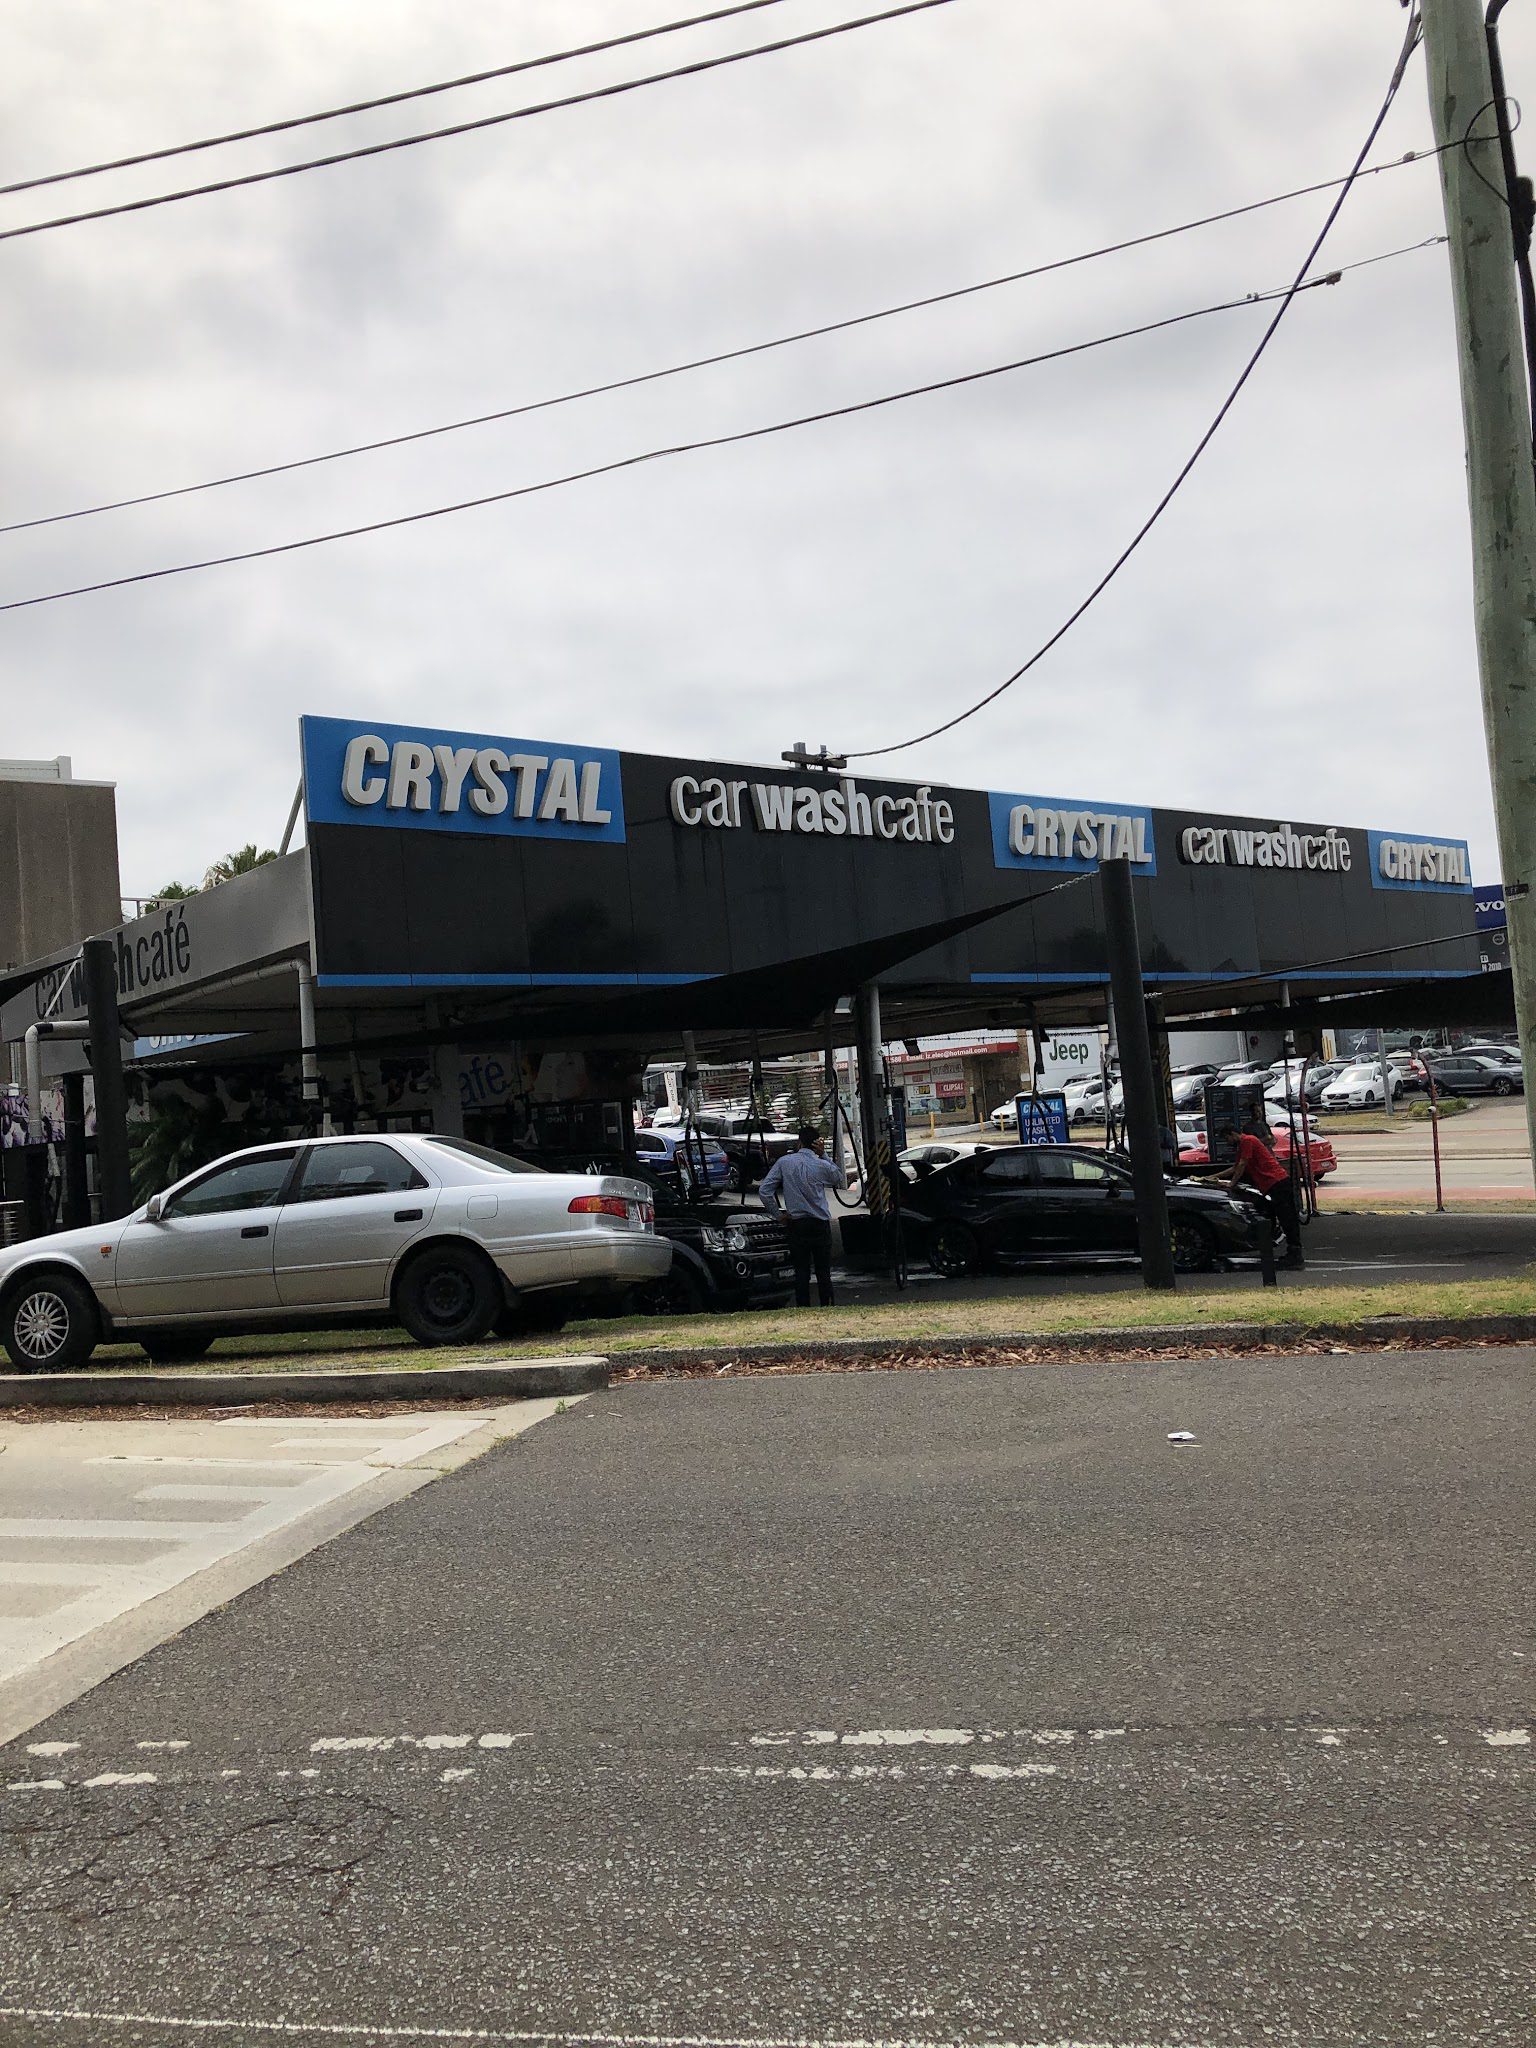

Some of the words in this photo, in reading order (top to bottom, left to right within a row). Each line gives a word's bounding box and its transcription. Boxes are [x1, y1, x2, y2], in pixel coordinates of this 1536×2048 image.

[342, 735, 611, 823] CRYSTAL
[670, 776, 747, 828] car
[1008, 804, 1152, 863] CRYSTAL
[1182, 826, 1227, 864] car
[1380, 839, 1470, 884] CRYSTAL
[1475, 900, 1505, 912] VO
[1049, 1039, 1088, 1064] Jeep
[459, 1056, 512, 1106] afé
[943, 1083, 964, 1091] CLIPSAL
[1023, 1101, 1060, 1114] CSAL
[1025, 1125, 1054, 1135] WASHS
